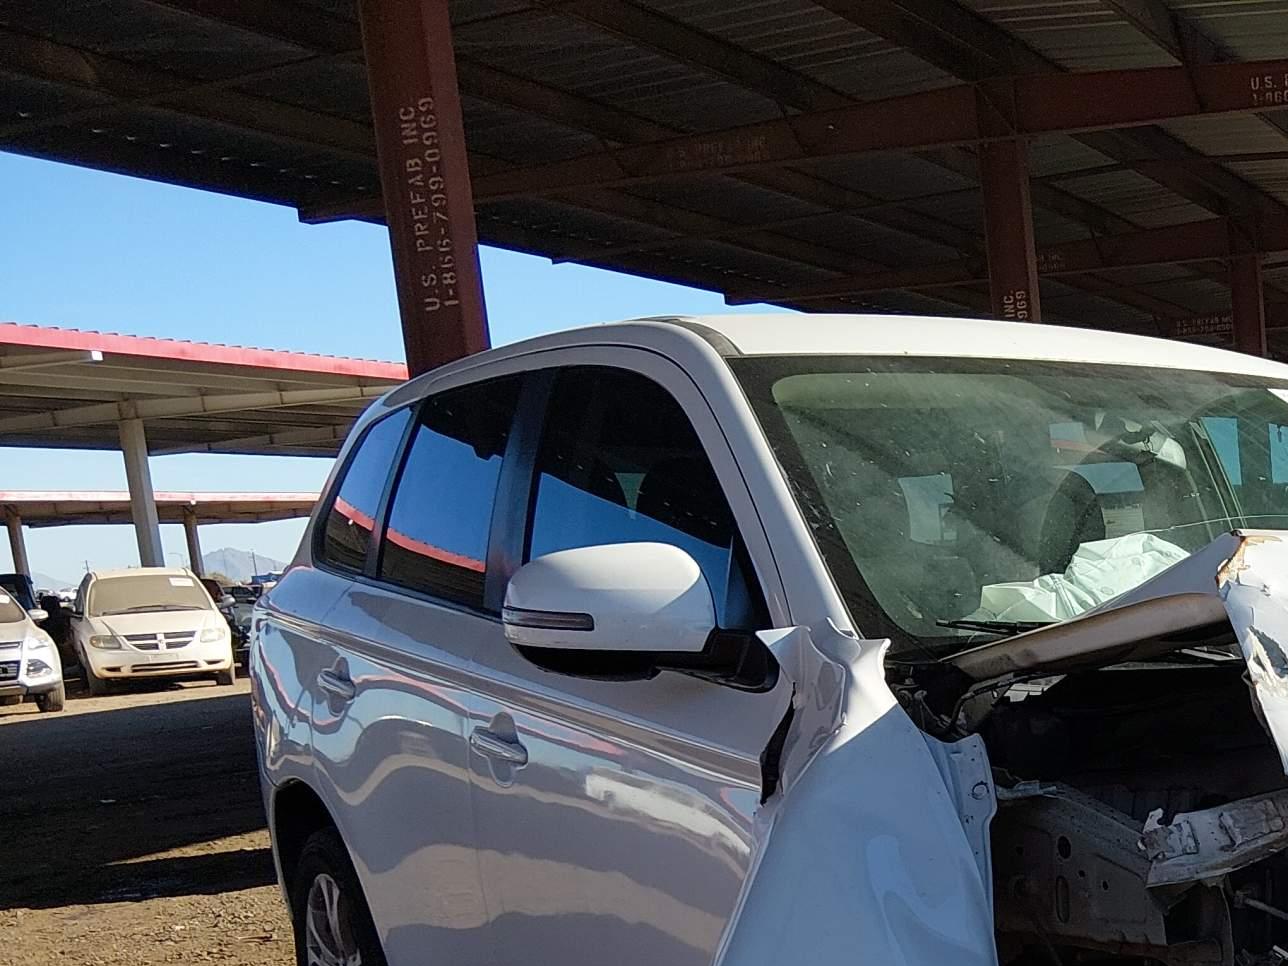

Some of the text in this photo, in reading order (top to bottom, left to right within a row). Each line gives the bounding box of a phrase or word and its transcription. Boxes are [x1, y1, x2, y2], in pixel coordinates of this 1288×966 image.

[1250, 76, 1277, 90] U.S.
[406, 157, 434, 252] PREFAB
[417, 97, 460, 308] 1-866-799-0969
[421, 265, 441, 312] U.S.
